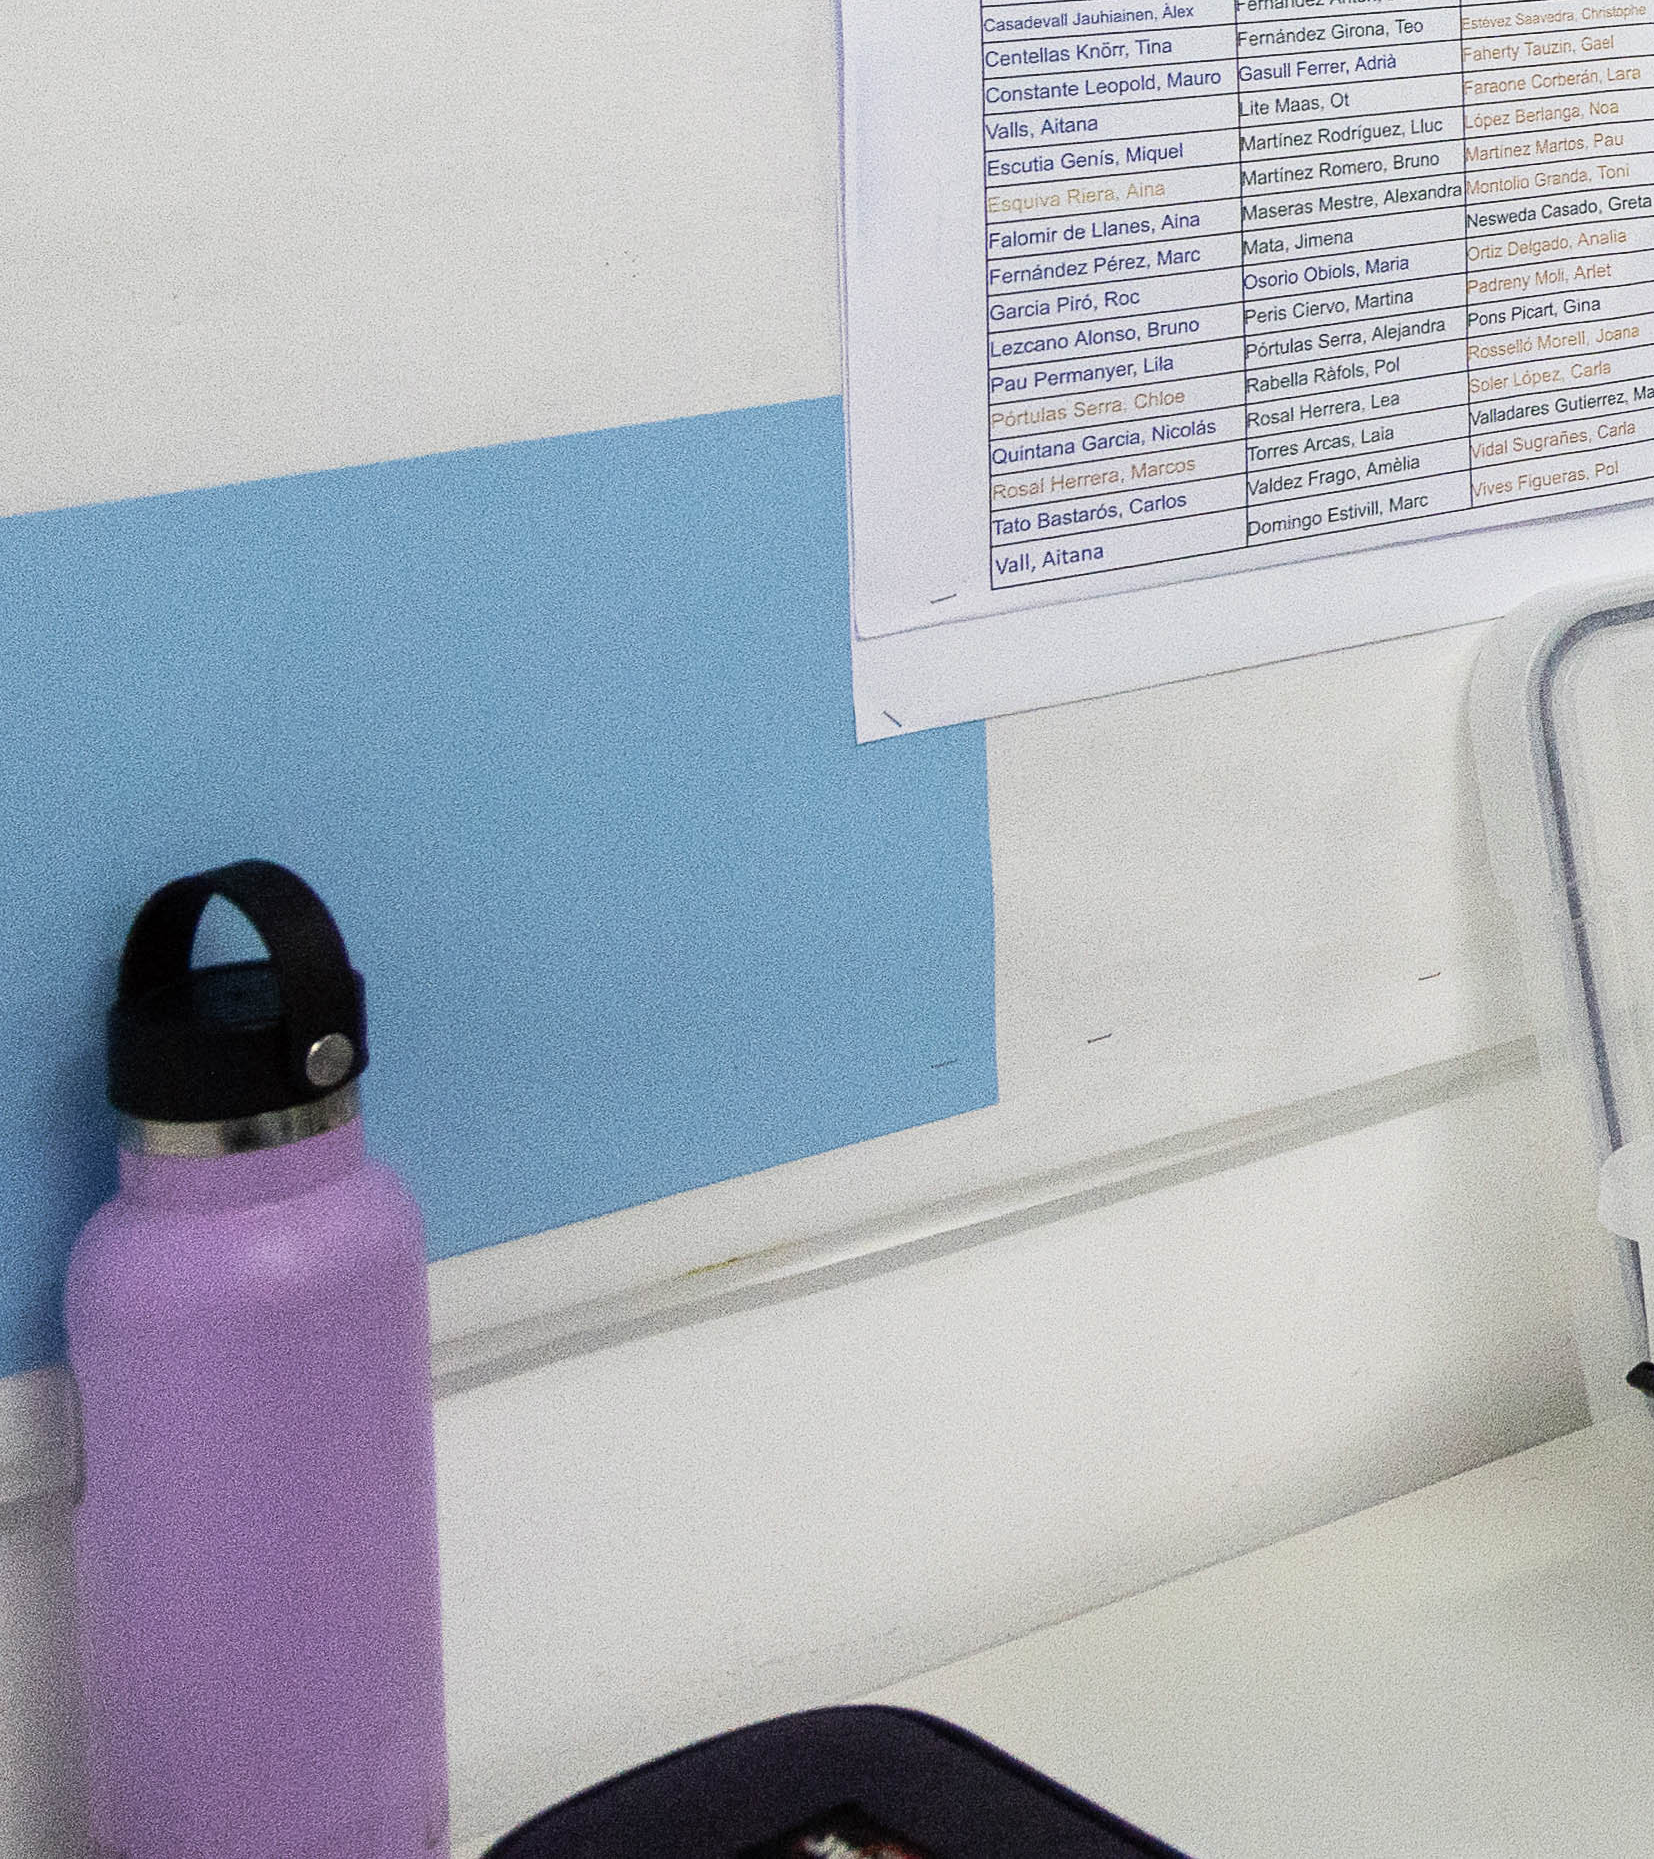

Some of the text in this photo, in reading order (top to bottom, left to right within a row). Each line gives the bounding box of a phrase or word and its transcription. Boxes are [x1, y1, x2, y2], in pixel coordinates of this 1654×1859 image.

[990, 248, 1201, 287] Fernández Pérez, Marc
[991, 419, 1217, 468] Quintana Garcia, Nicolás
